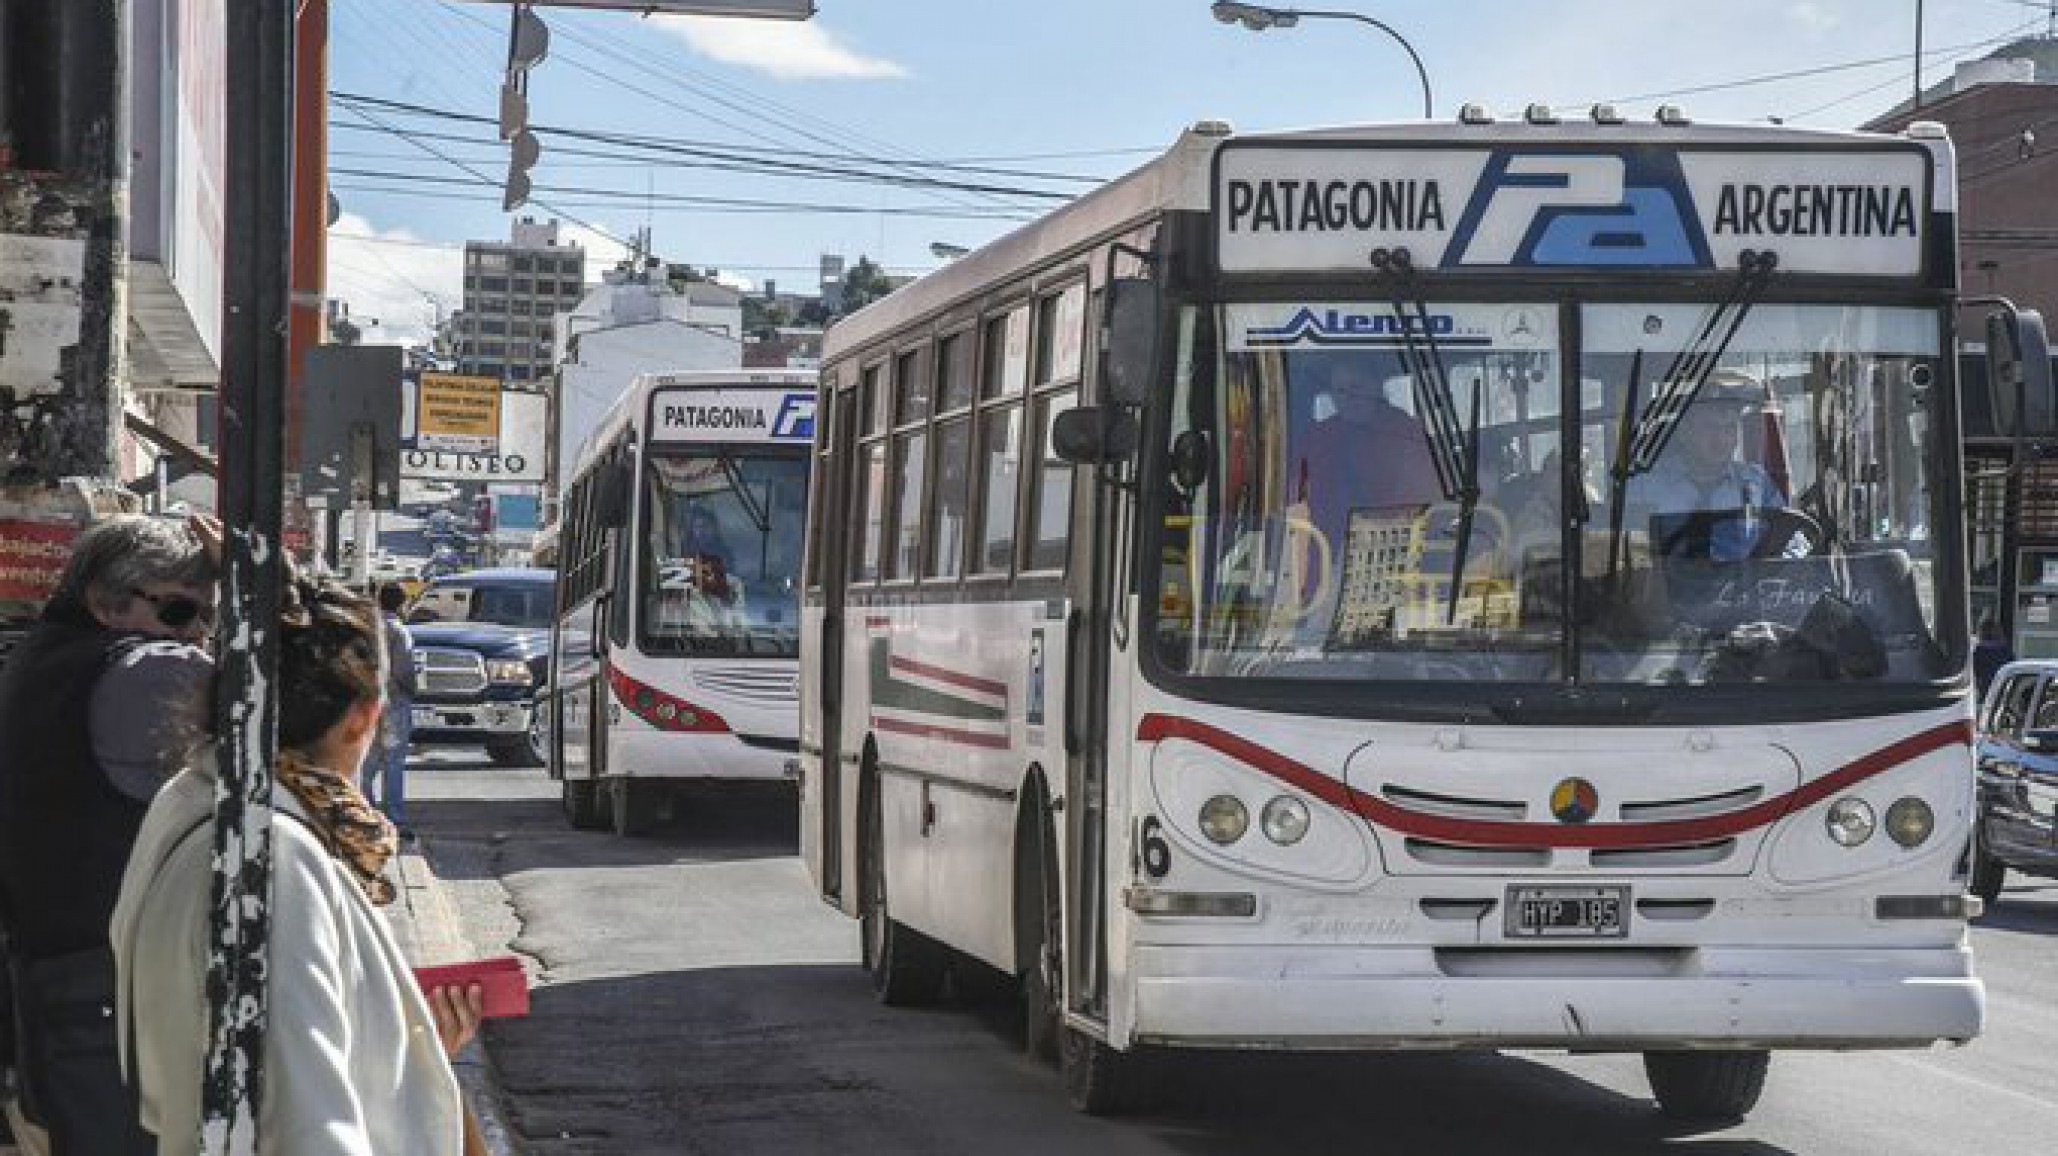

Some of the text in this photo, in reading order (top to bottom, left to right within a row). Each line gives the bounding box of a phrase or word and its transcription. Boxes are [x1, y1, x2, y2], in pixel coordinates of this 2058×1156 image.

[1229, 180, 1445, 232] PATAGONIA
[1714, 185, 1917, 237] ARGENTINA
[665, 406, 766, 428] PATAGONIA
[407, 450, 526, 473] OLISEO
[1523, 900, 1619, 926] HYP 185
